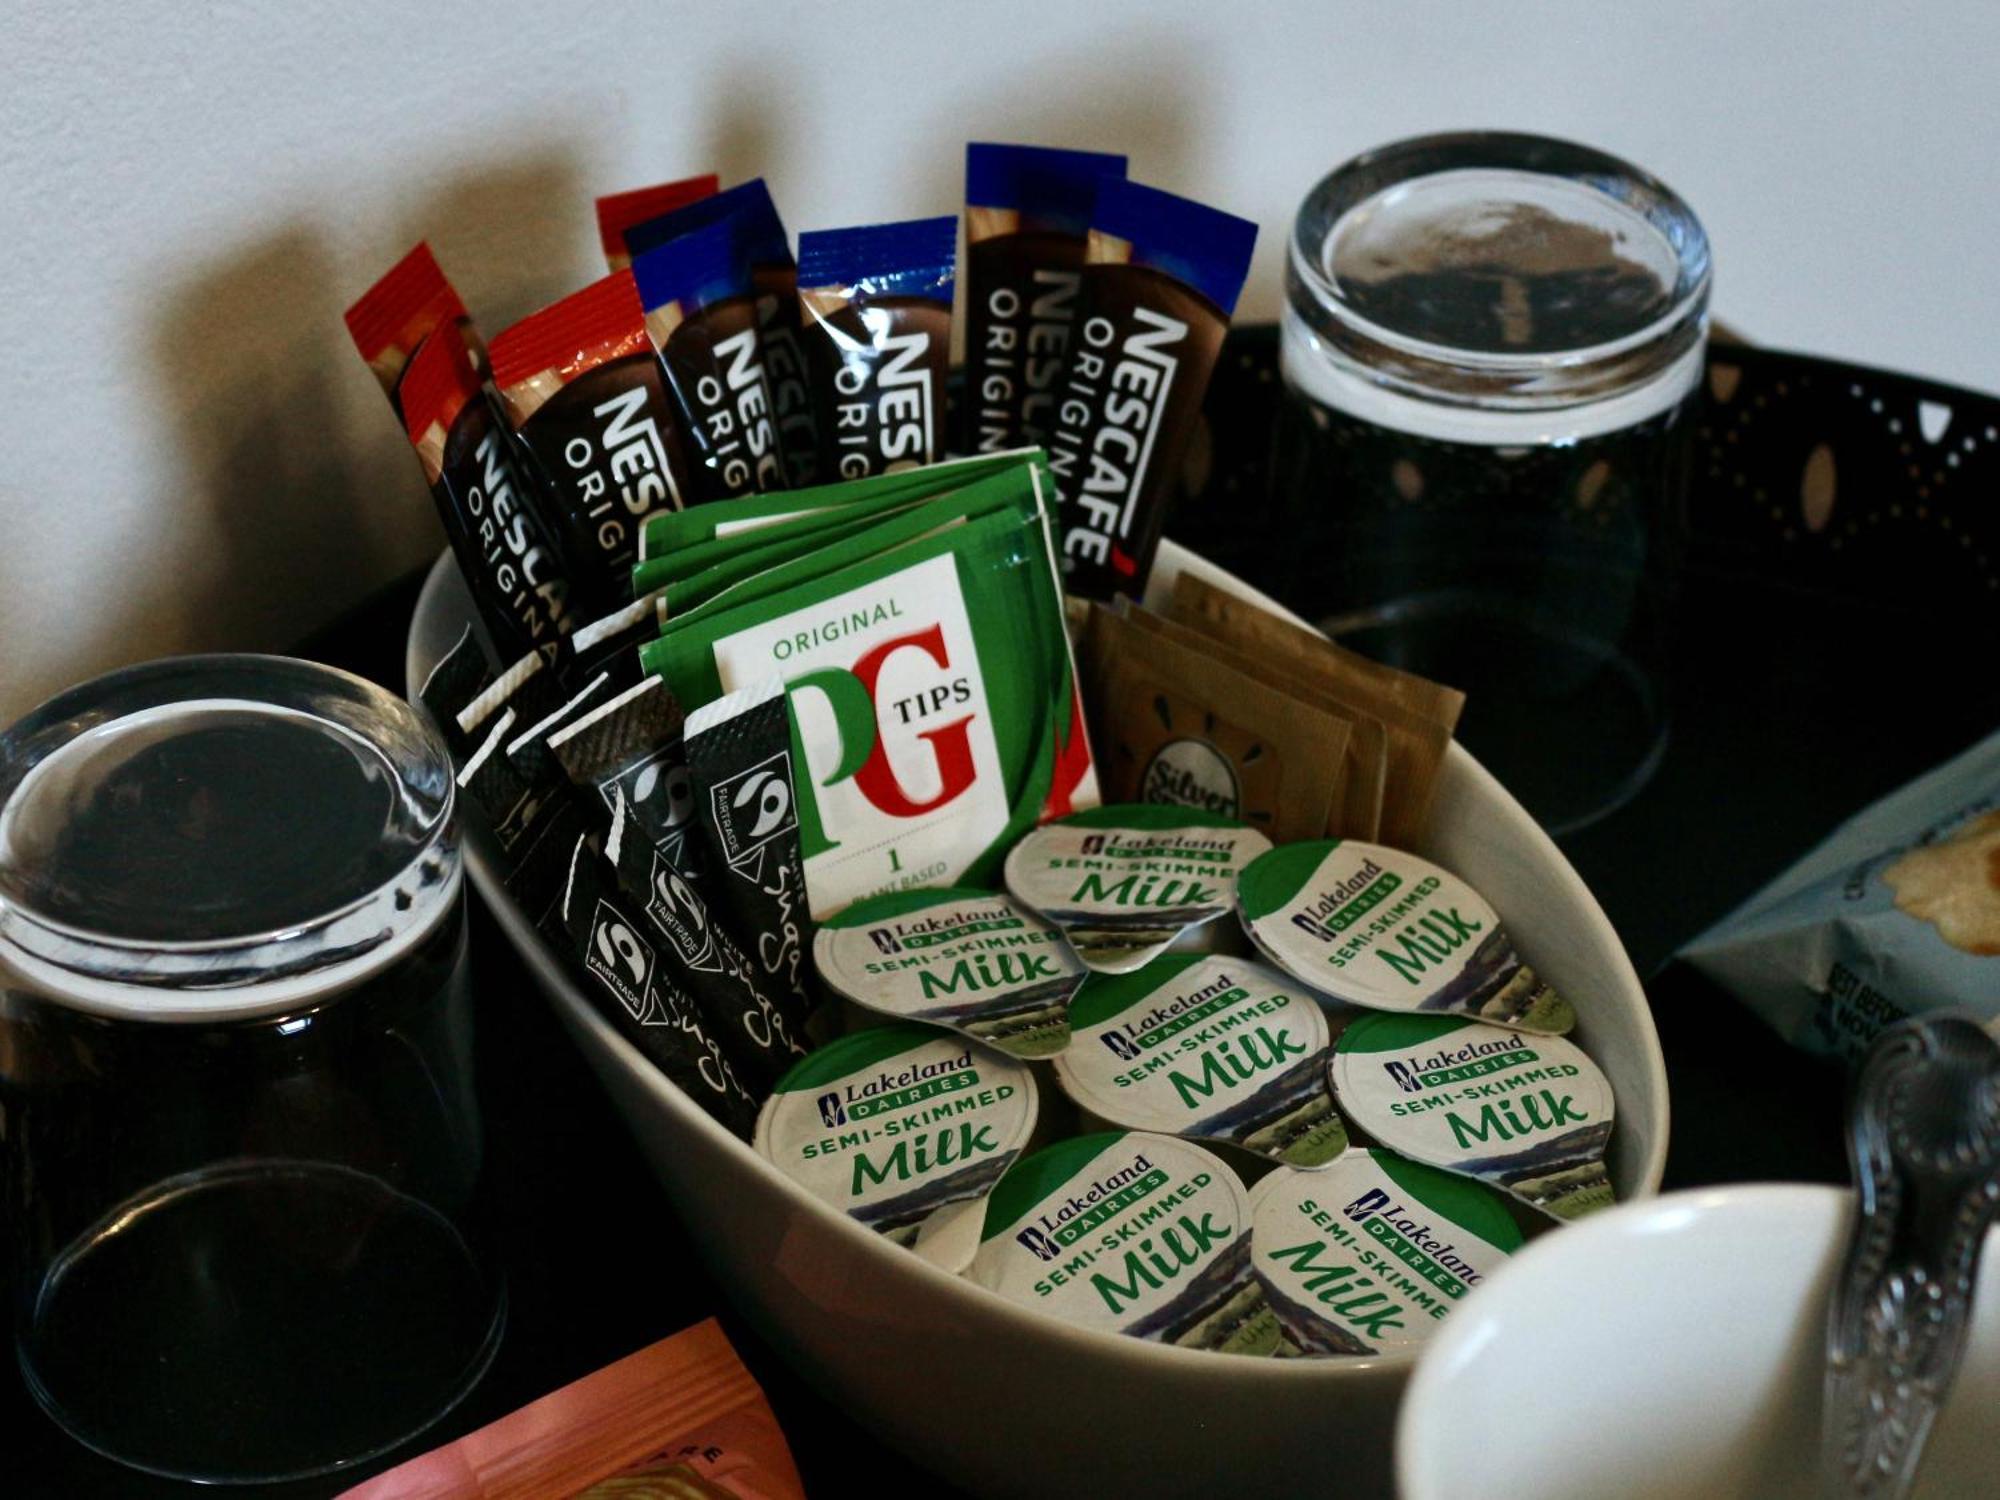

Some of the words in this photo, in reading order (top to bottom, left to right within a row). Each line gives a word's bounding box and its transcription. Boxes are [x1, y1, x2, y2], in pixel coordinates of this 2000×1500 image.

[977, 287, 1021, 451] ORIGIN
[697, 375, 750, 489] ORIG
[834, 362, 871, 480] ORIG
[772, 599, 903, 660] ORIGINAL
[893, 678, 972, 726] TIPS
[785, 622, 977, 861] PG
[717, 786, 740, 854] FAIRTRADE
[1111, 835, 1237, 851] Lakeland
[900, 861, 948, 890] BASED
[1049, 858, 1235, 878] SEMI-SKIMME
[1071, 873, 1218, 907] Milk
[1304, 859, 1383, 921] Lakeland
[652, 900, 698, 955] FAIRTRADE
[895, 906, 1014, 937] Lakeland
[1328, 875, 1441, 968] SEMI-SKIMMED
[1332, 876, 1398, 930] DAIRIES
[918, 951, 1061, 999] Milk
[1375, 903, 1482, 986] Milk
[588, 956, 641, 1009] FAIRTRADE
[1124, 974, 1237, 1038] Lakeland
[1113, 994, 1291, 1088] SEMI-SKIMMED
[1145, 991, 1242, 1047] DAIRIES
[845, 1051, 975, 1104] Lakeland
[1167, 1026, 1307, 1109] Milk
[1408, 1035, 1527, 1073] Lakeland
[1431, 1052, 1533, 1087] DAIRIES
[856, 1074, 972, 1117] DAIRIES
[1390, 1064, 1580, 1117] SEMI-SKIMMED
[1445, 1089, 1590, 1149] Milk
[802, 1085, 1015, 1160] SEMI-SKIMMED
[851, 1122, 999, 1196] Milk
[1041, 1153, 1155, 1232] Lakeland
[1061, 1173, 1163, 1241] DAIRIES
[1033, 1171, 1213, 1298] SEMI-SKIMMED
[1089, 1208, 1233, 1316] Milk
[1298, 1199, 1450, 1321] SEMI-SKIMME
[1370, 1223, 1463, 1296] DAIRIES
[1268, 1239, 1405, 1340] Milk
